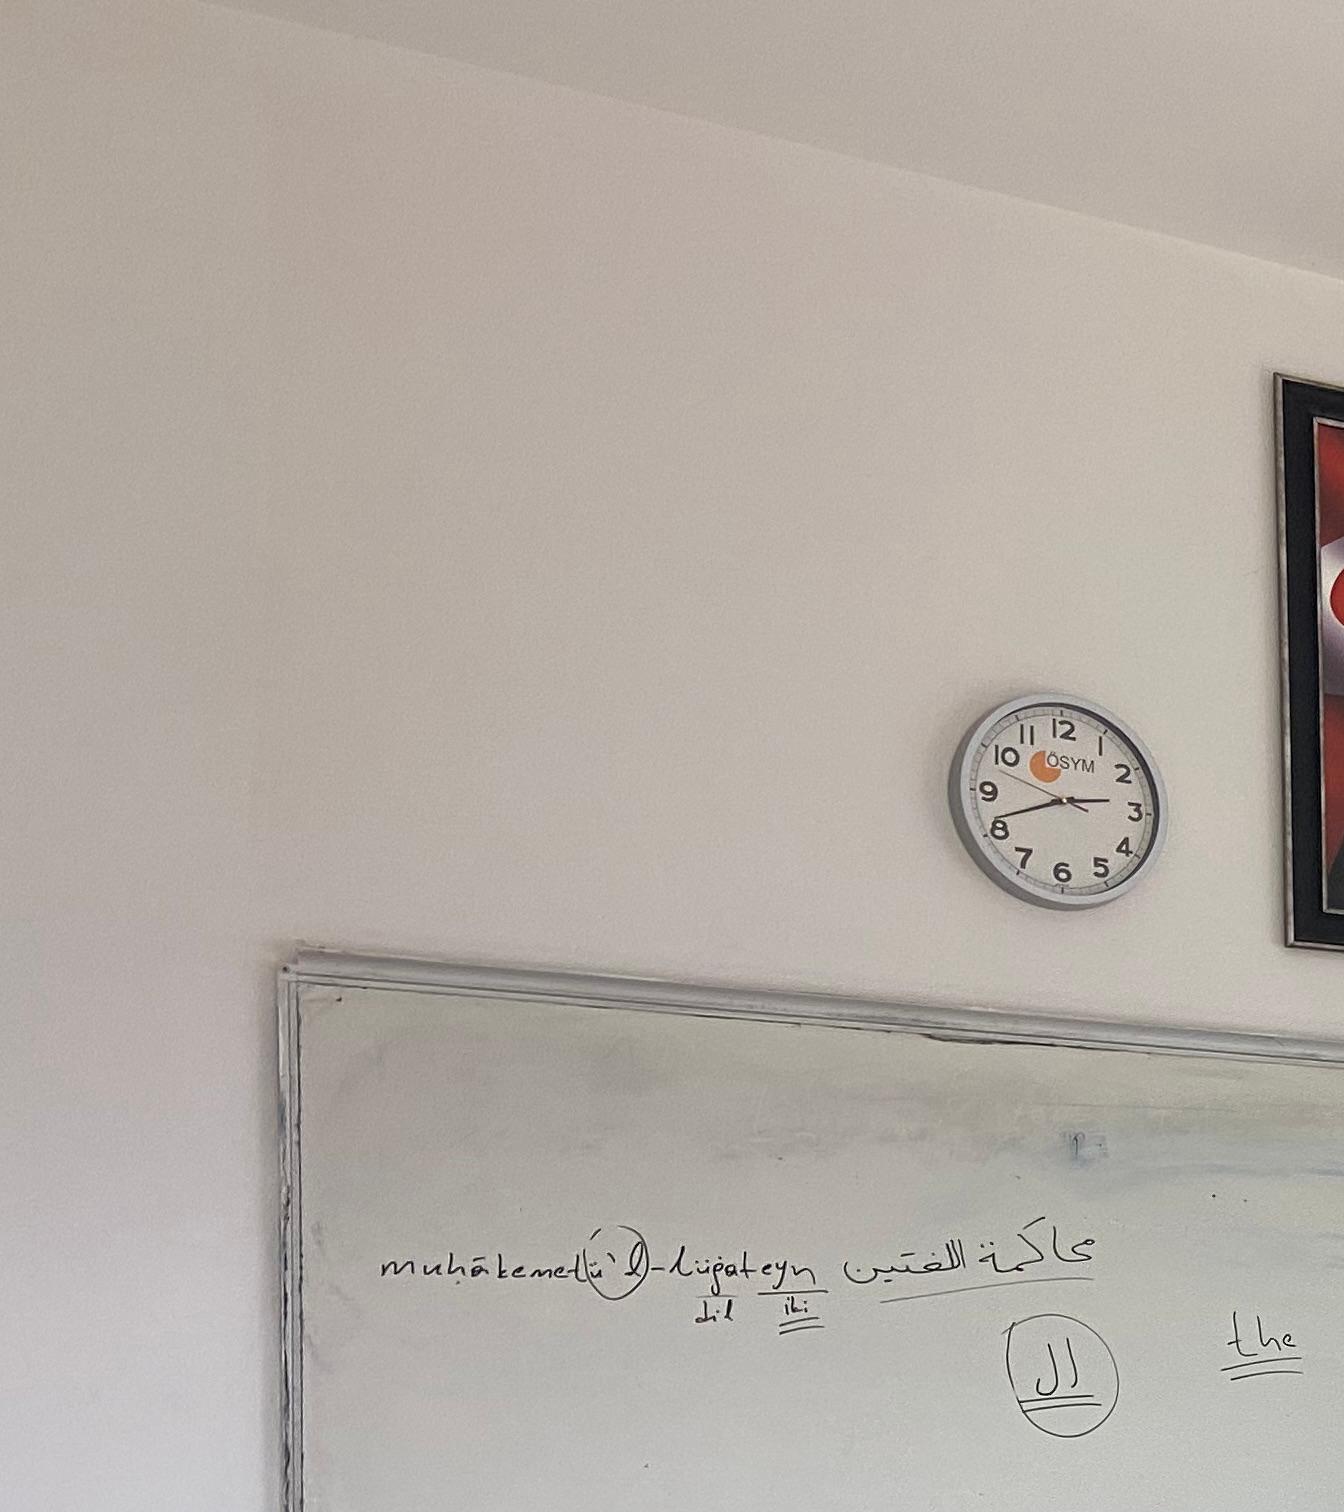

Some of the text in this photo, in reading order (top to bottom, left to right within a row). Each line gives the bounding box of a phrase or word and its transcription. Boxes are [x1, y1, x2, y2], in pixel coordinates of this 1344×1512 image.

[1020, 724, 1035, 746] 11
[1052, 718, 1077, 742] 12
[994, 744, 1020, 768] 10
[1098, 735, 1104, 757] 1
[1046, 752, 1095, 774] ÖSYM
[1114, 763, 1132, 784] 2
[979, 780, 999, 802] 9
[1127, 801, 1143, 823] 3
[989, 819, 1010, 841] 8
[1014, 846, 1034, 870] 7
[1116, 837, 1134, 857] 4
[1052, 862, 1073, 883] 6
[1092, 857, 1110, 879] 5
[695, 1299, 734, 1324] dil
[1226, 1310, 1298, 1358] the
